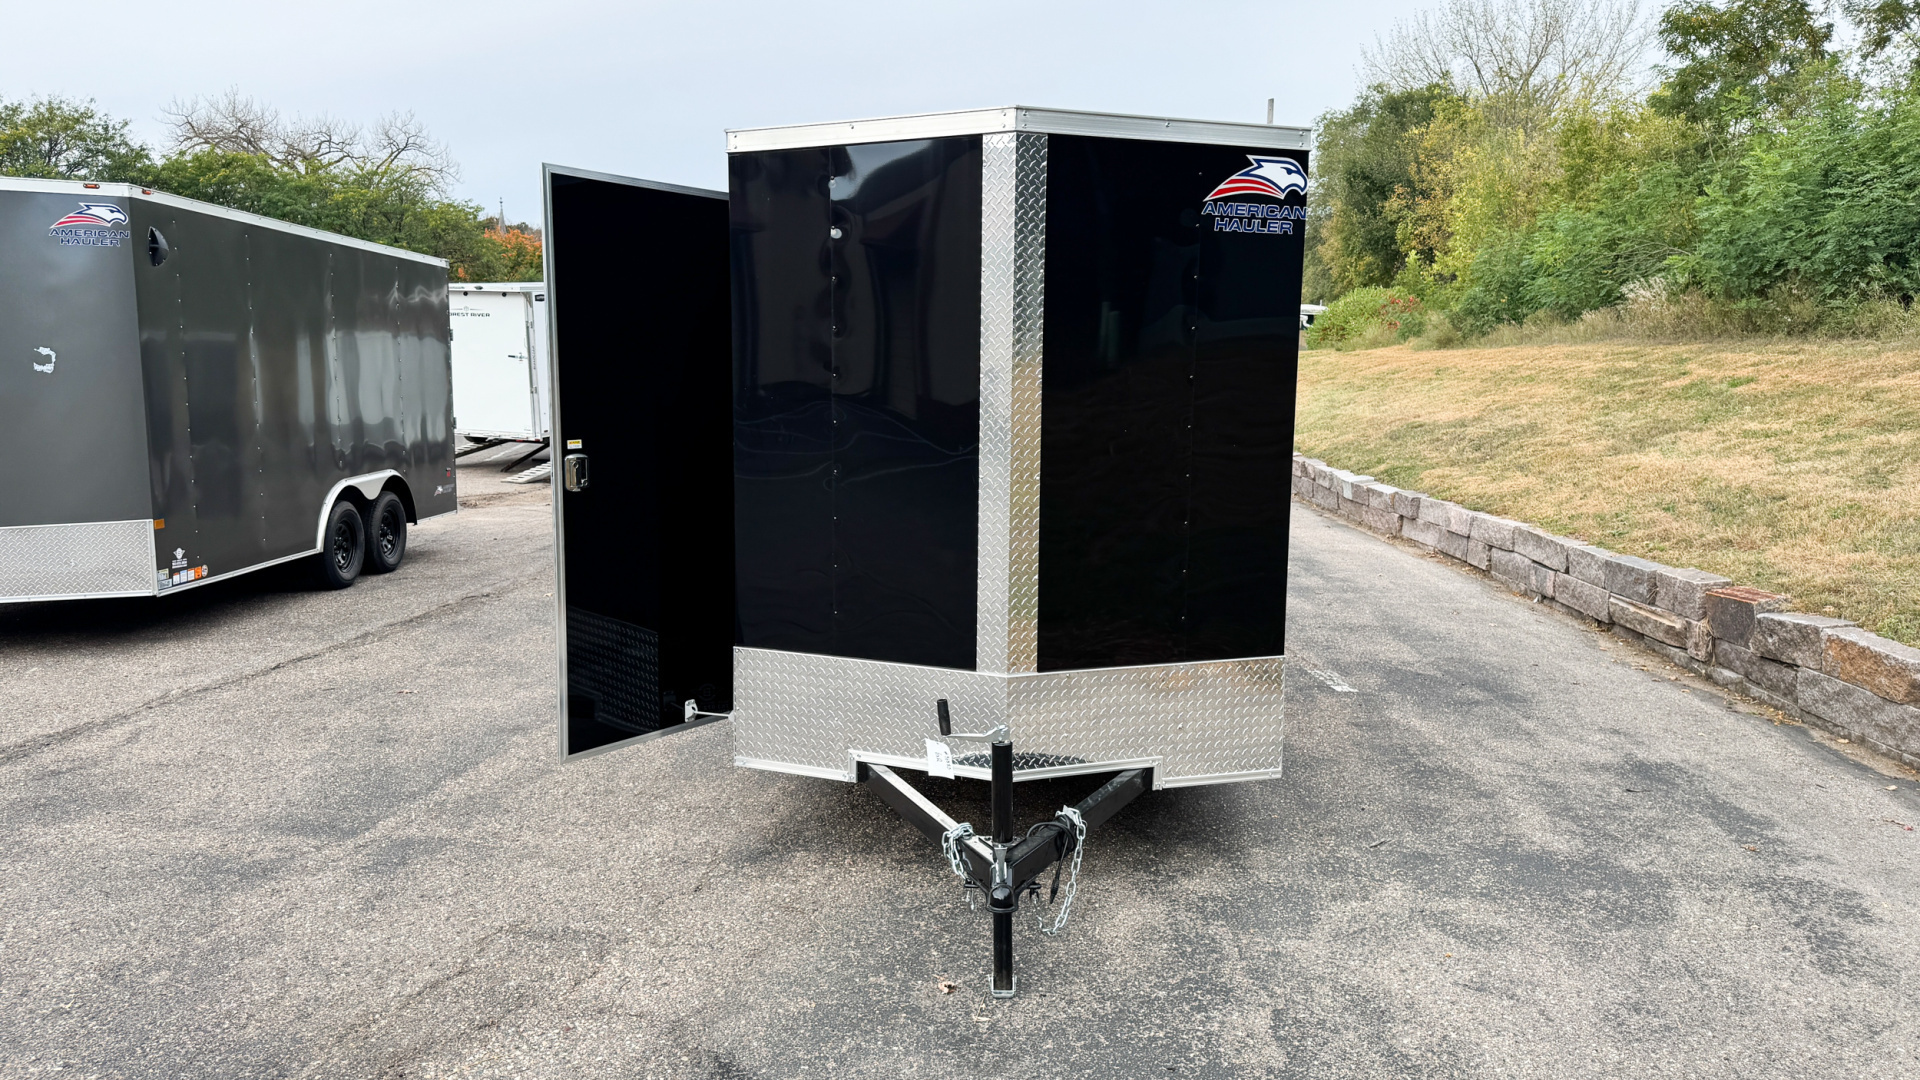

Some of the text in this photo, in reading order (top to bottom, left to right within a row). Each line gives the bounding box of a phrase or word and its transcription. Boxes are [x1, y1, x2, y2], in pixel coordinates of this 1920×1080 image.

[1201, 201, 1307, 219] AMERICAN
[48, 228, 130, 238] AMERICAN
[1214, 217, 1293, 235] HAULER
[60, 237, 121, 247] HAULER
